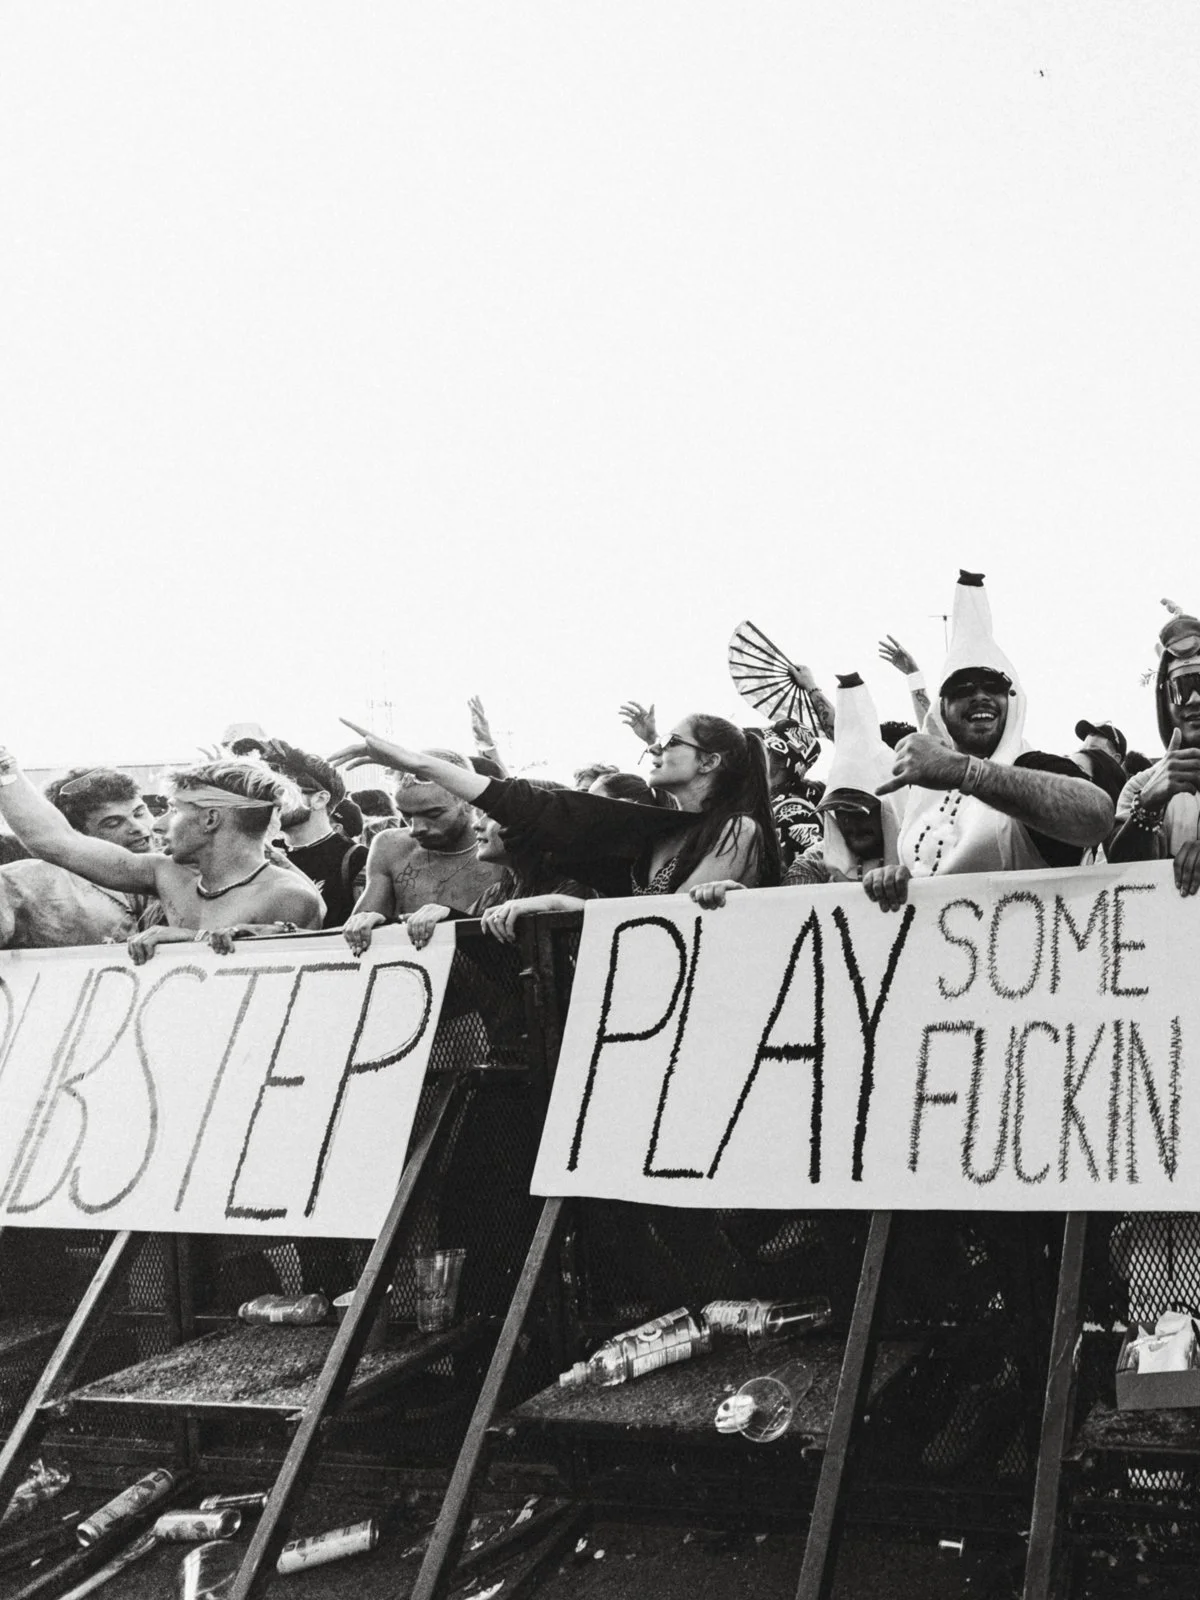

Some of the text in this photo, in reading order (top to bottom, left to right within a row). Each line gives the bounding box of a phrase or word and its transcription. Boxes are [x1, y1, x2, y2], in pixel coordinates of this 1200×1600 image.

[567, 905, 916, 1184] PLAY
[937, 883, 1157, 1000] SOME
[0, 962, 433, 1218] UBSTEP
[908, 1015, 1182, 1186] FUCKIN
